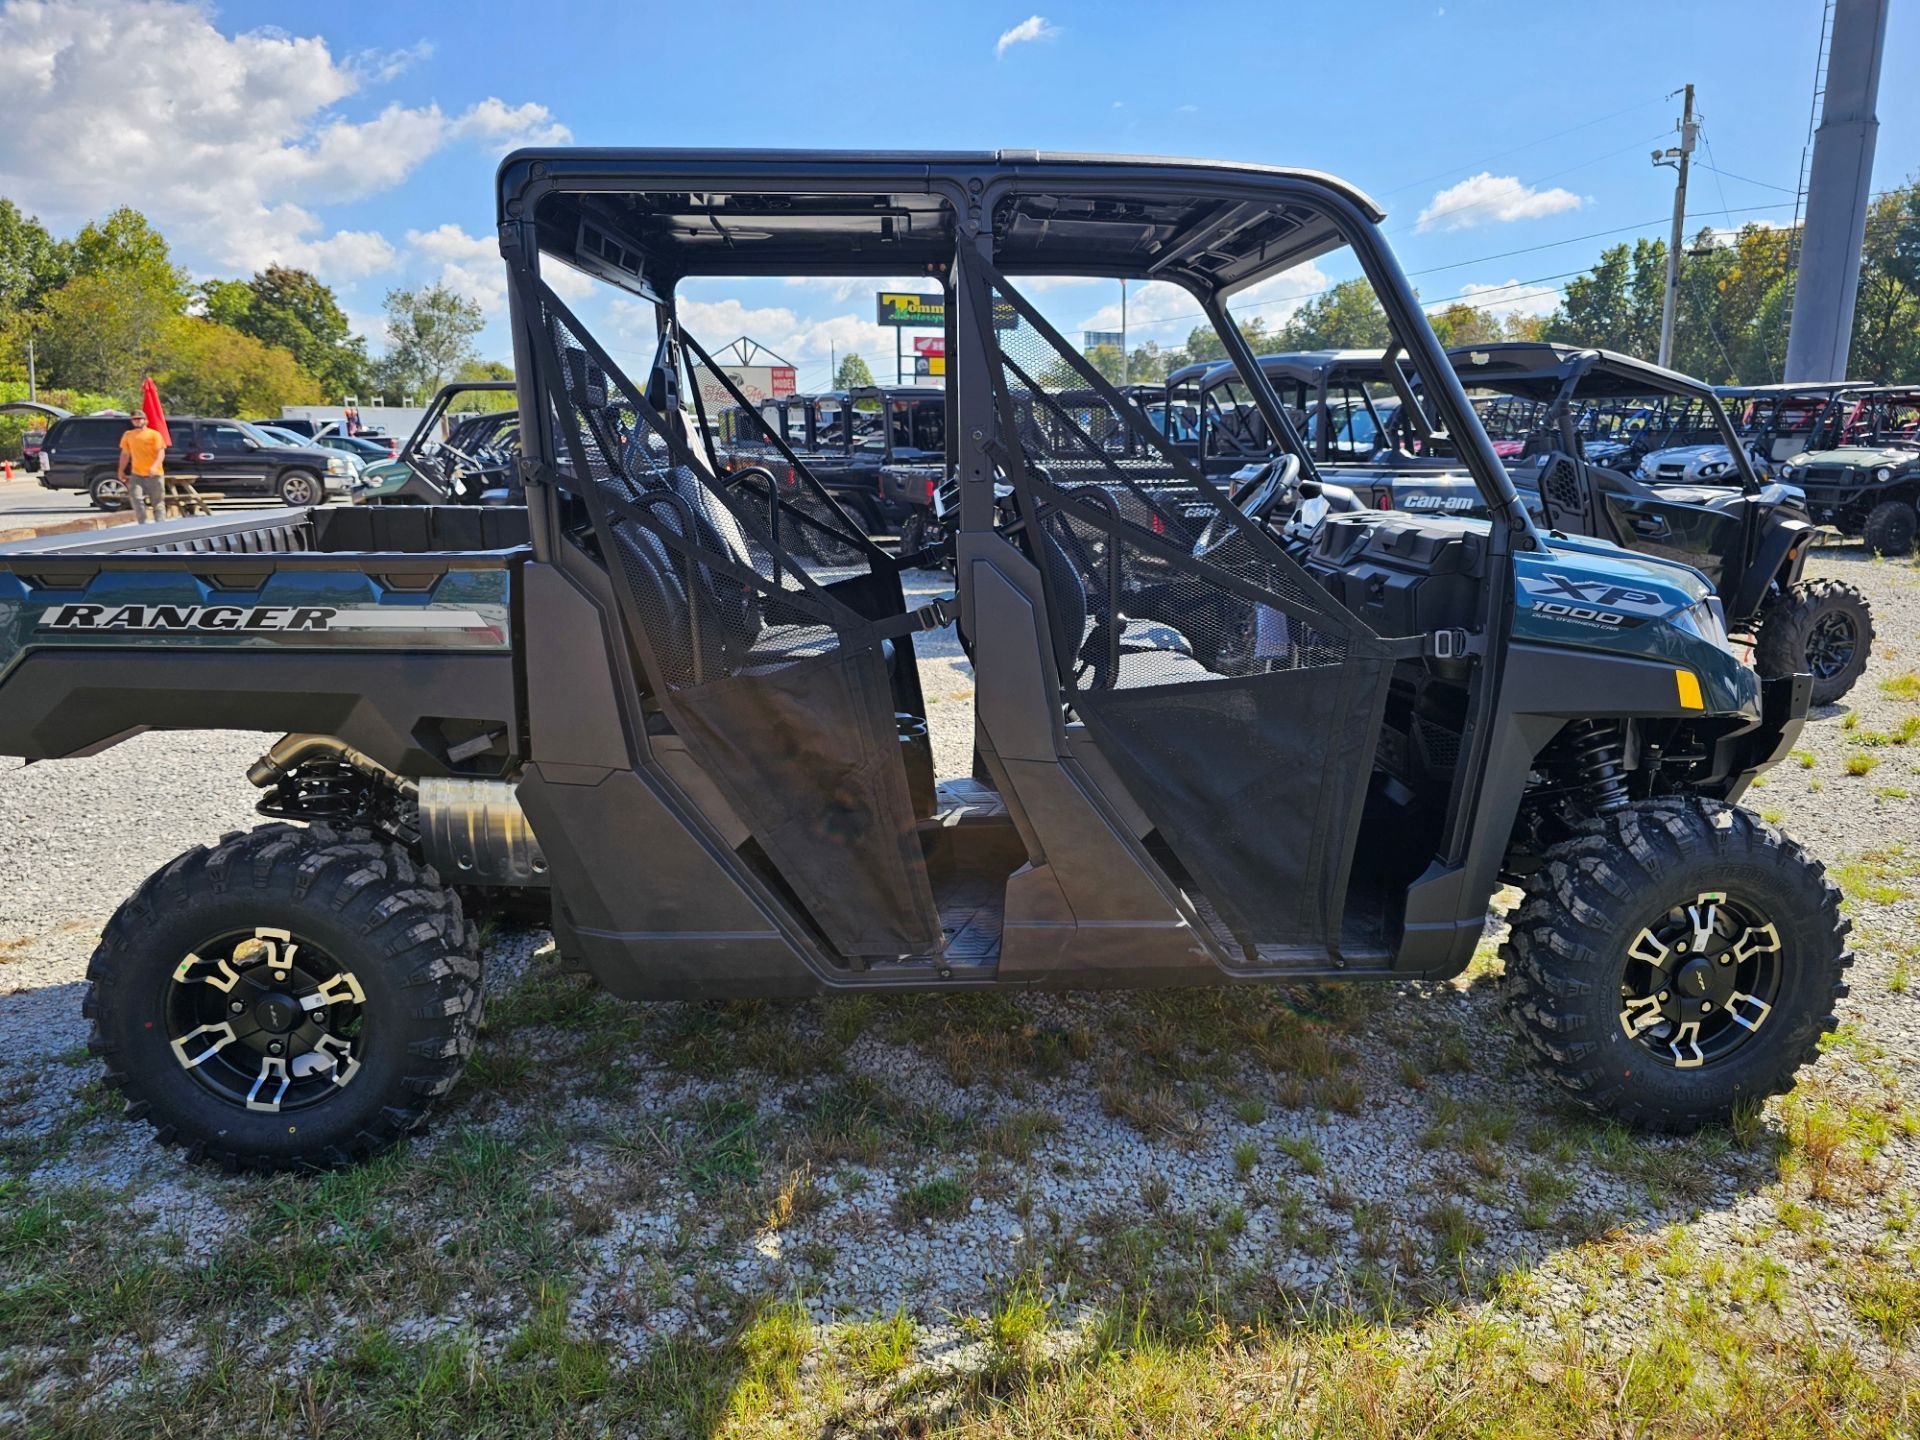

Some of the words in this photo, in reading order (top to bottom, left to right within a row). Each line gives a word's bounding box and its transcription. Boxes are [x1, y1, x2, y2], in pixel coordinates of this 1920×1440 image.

[882, 294, 945, 313] Tomm
[773, 379, 795, 389] MODEL
[1404, 495, 1474, 510] can-am
[1531, 573, 1664, 606] XP
[50, 603, 338, 632] RANGER
[1532, 600, 1624, 625] 1000
[1531, 613, 1555, 621] DUAL
[1555, 616, 1601, 629] OVERHEAD
[1600, 624, 1620, 632] CAM
